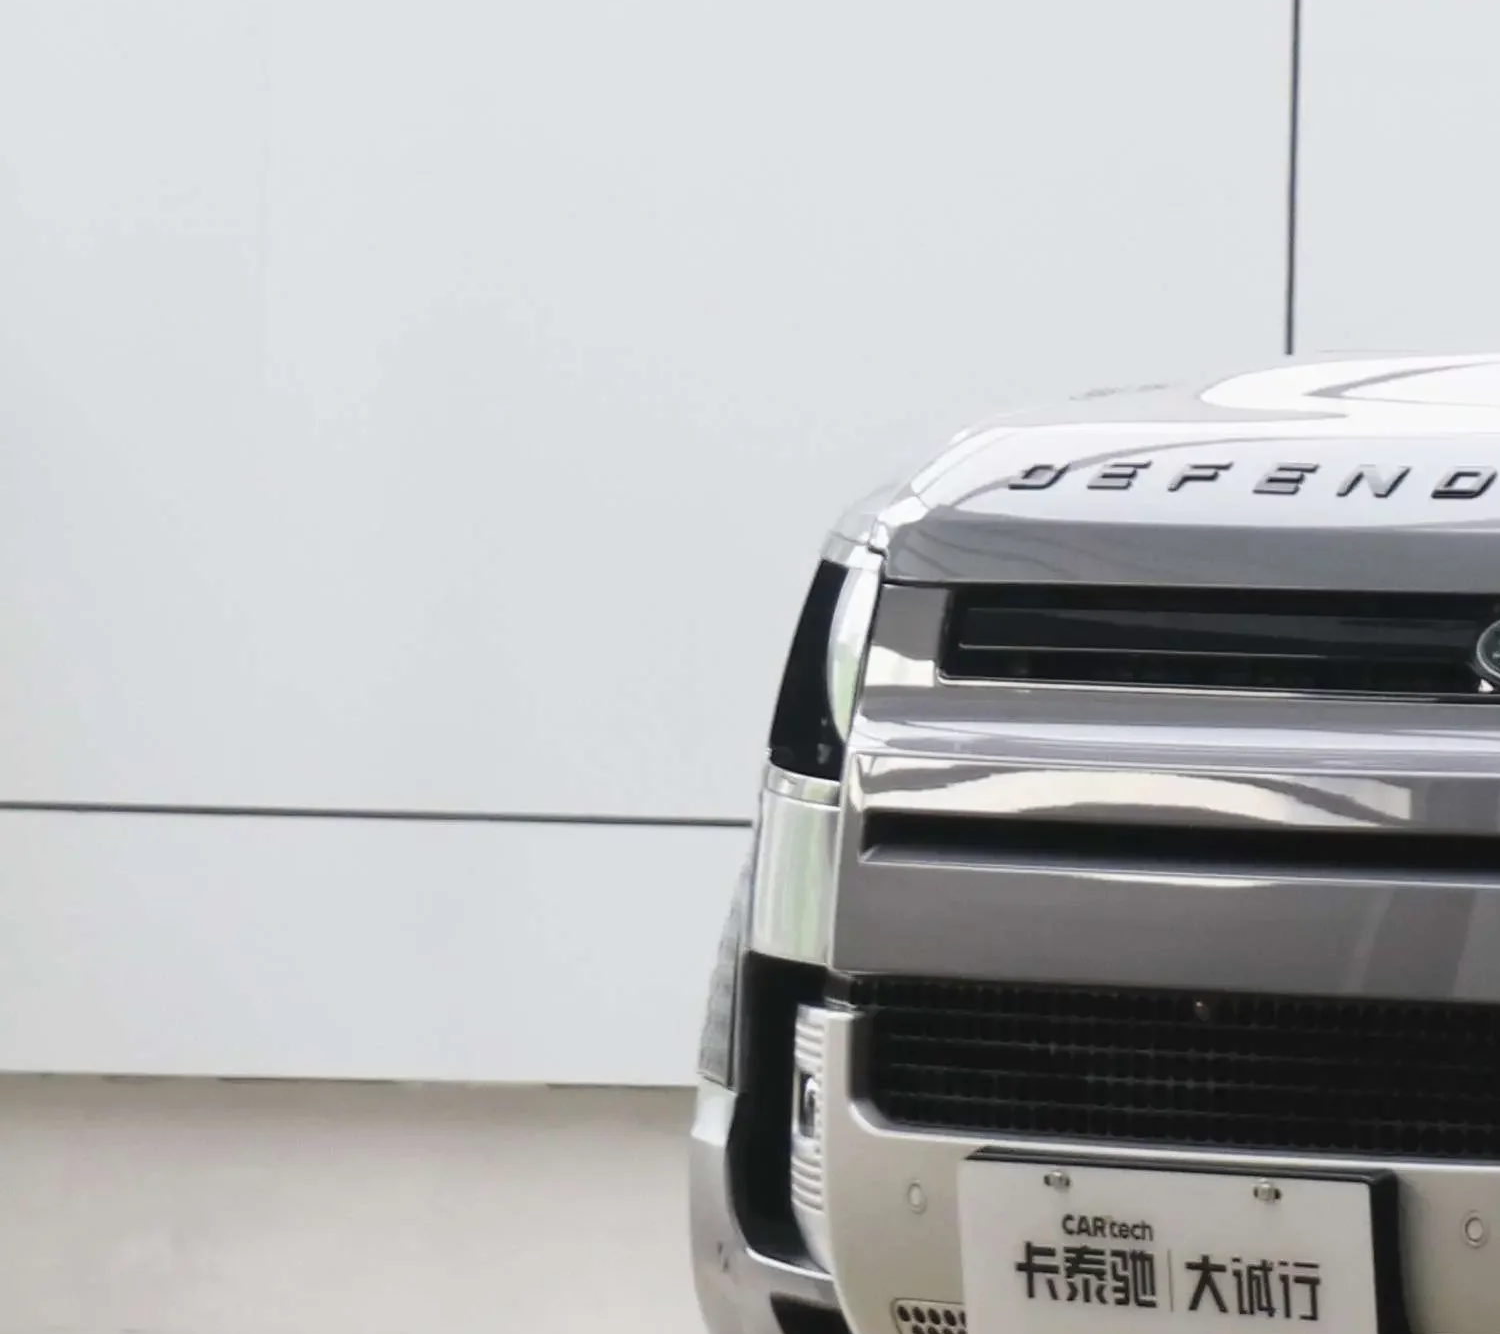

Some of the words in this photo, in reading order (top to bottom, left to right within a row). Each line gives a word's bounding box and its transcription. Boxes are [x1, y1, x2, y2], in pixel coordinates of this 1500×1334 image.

[1062, 1214, 1153, 1242] CARtech
[1015, 1241, 1157, 1309] 卡泰驰
[1185, 1254, 1321, 1322] 大诚行
